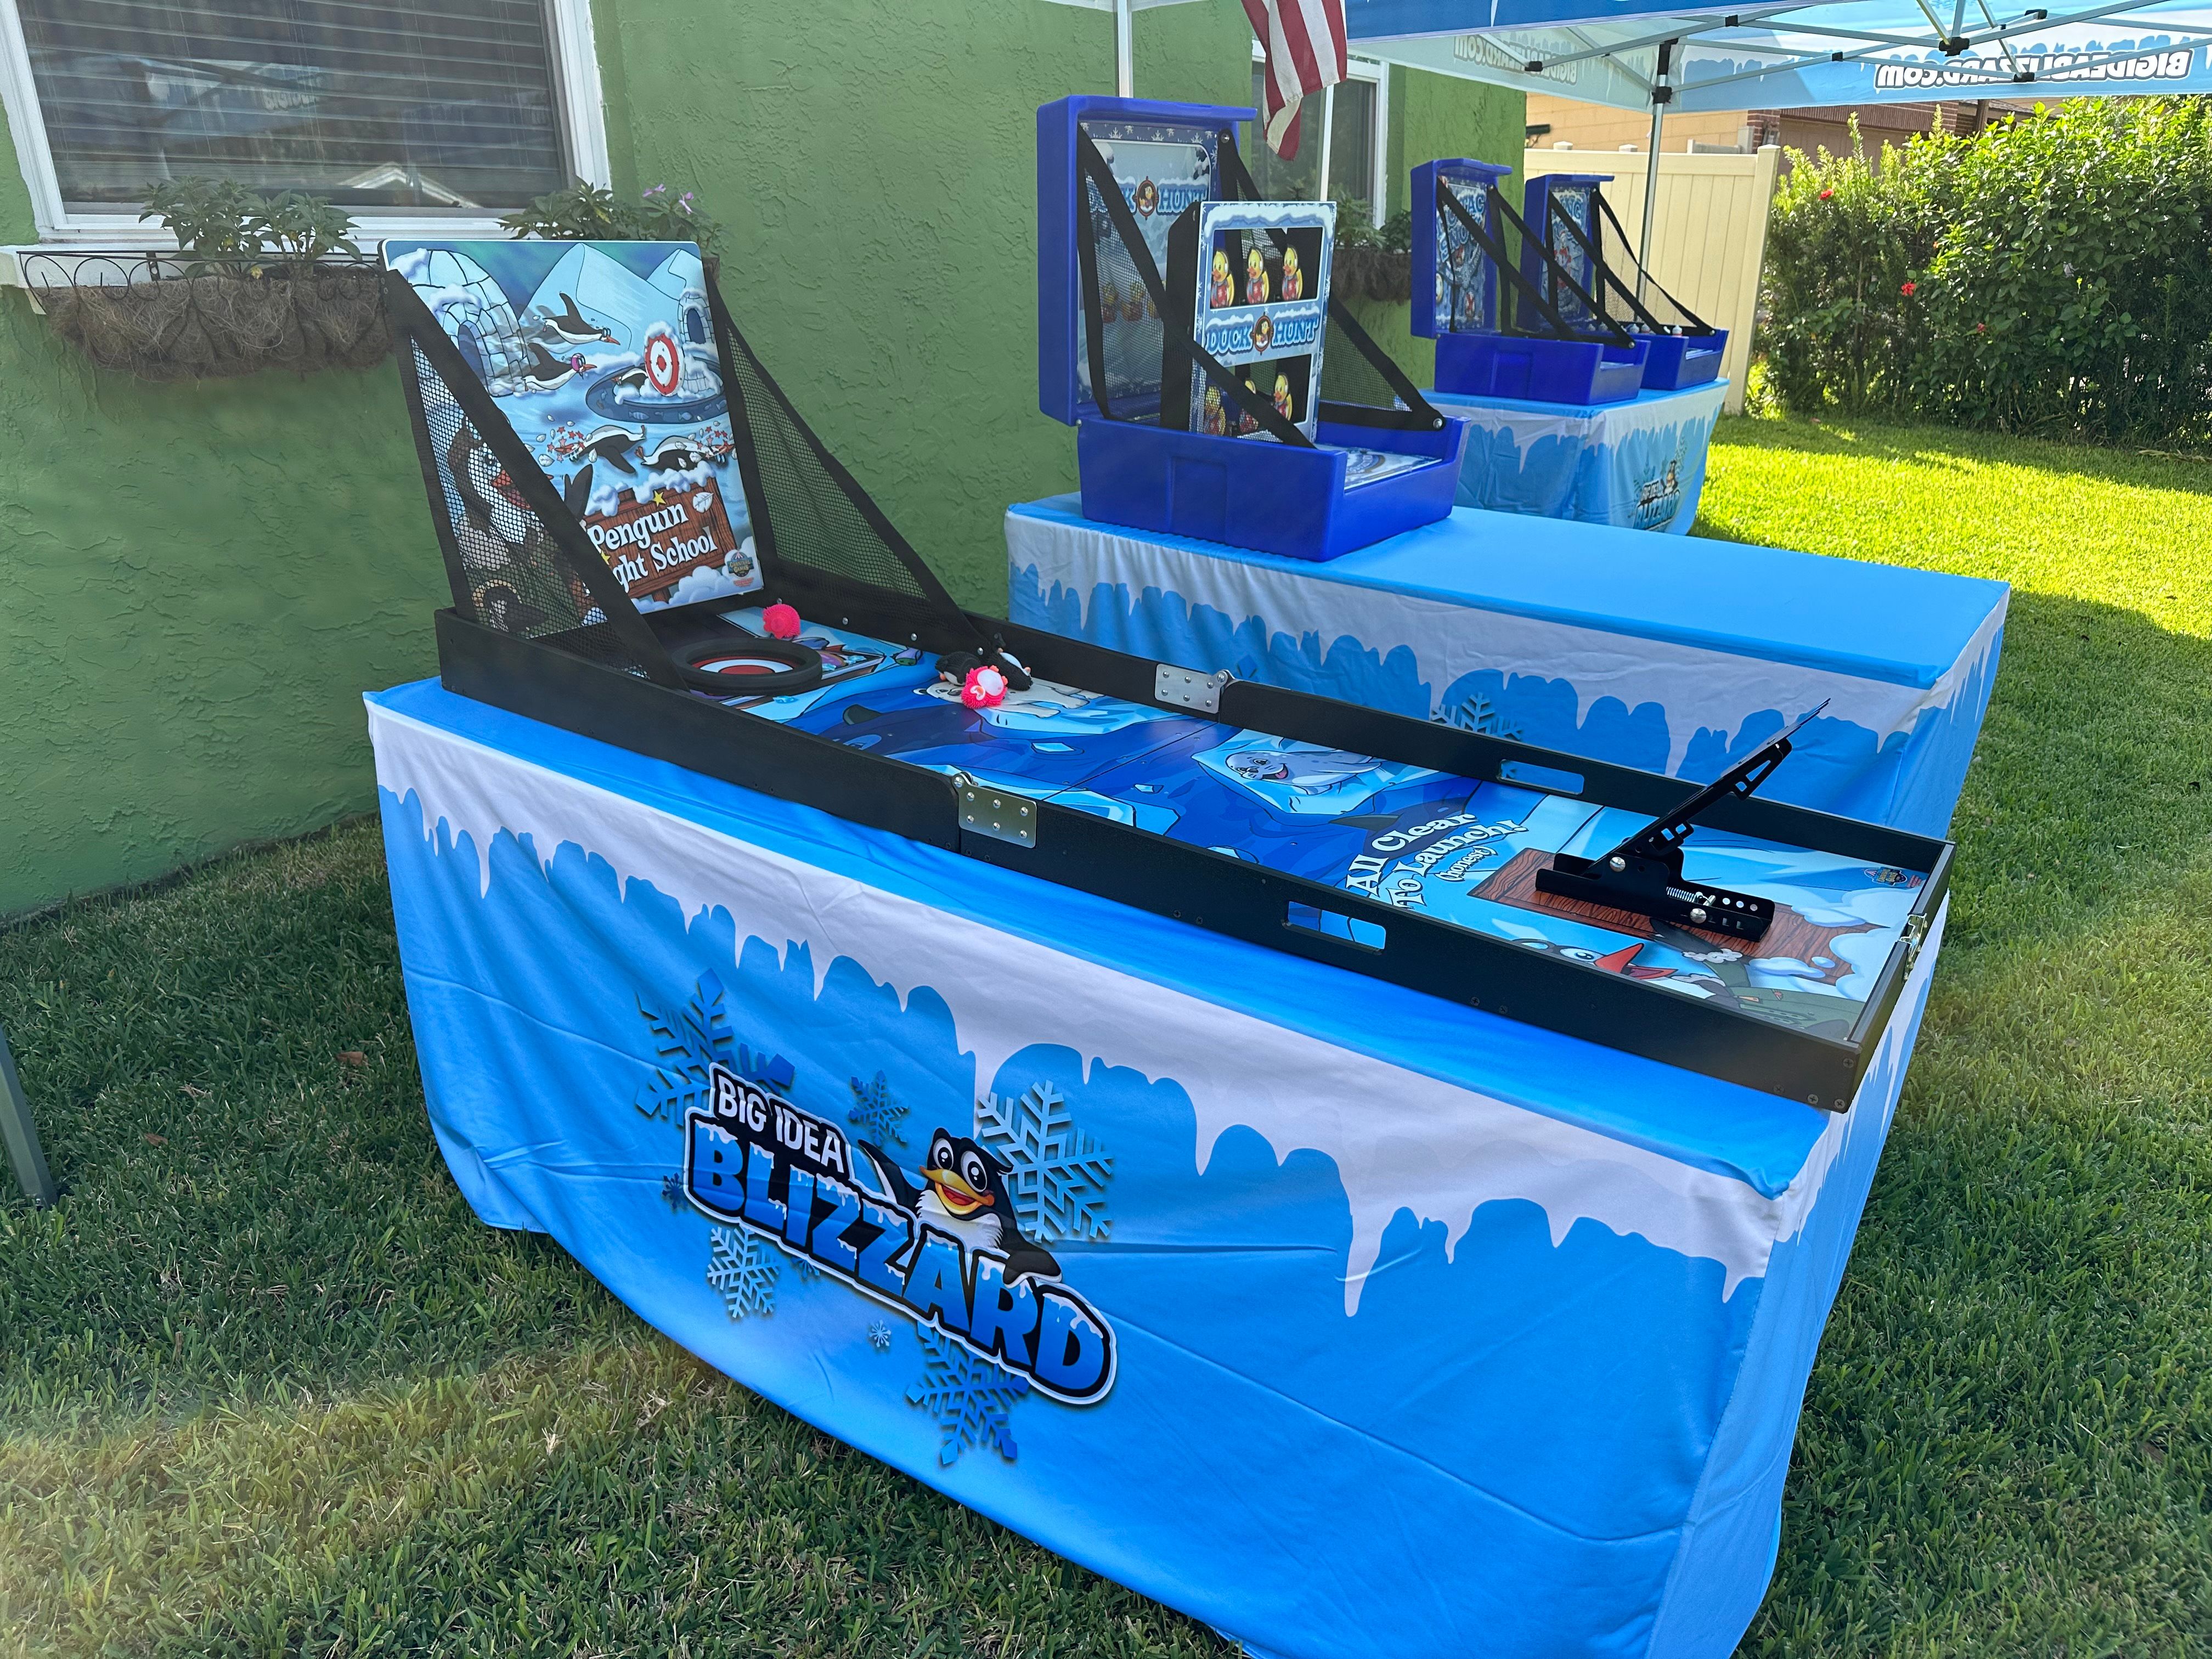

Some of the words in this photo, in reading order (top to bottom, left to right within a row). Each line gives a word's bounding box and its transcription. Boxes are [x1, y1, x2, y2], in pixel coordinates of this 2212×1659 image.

[1206, 324, 1254, 355] DUCK
[1272, 316, 1319, 347] HUNT
[587, 503, 689, 554] Penguin
[612, 553, 648, 593] ght
[651, 526, 718, 572] School
[1346, 854, 1389, 898] All
[1372, 814, 1479, 851] Clear
[1392, 820, 1529, 877] Launch!
[1434, 845, 1498, 882] (honest)
[1386, 878, 1427, 910] To
[717, 1074, 768, 1131] BIG
[774, 1104, 844, 1173] IDEA
[693, 1118, 1106, 1391] BLIZZARD
